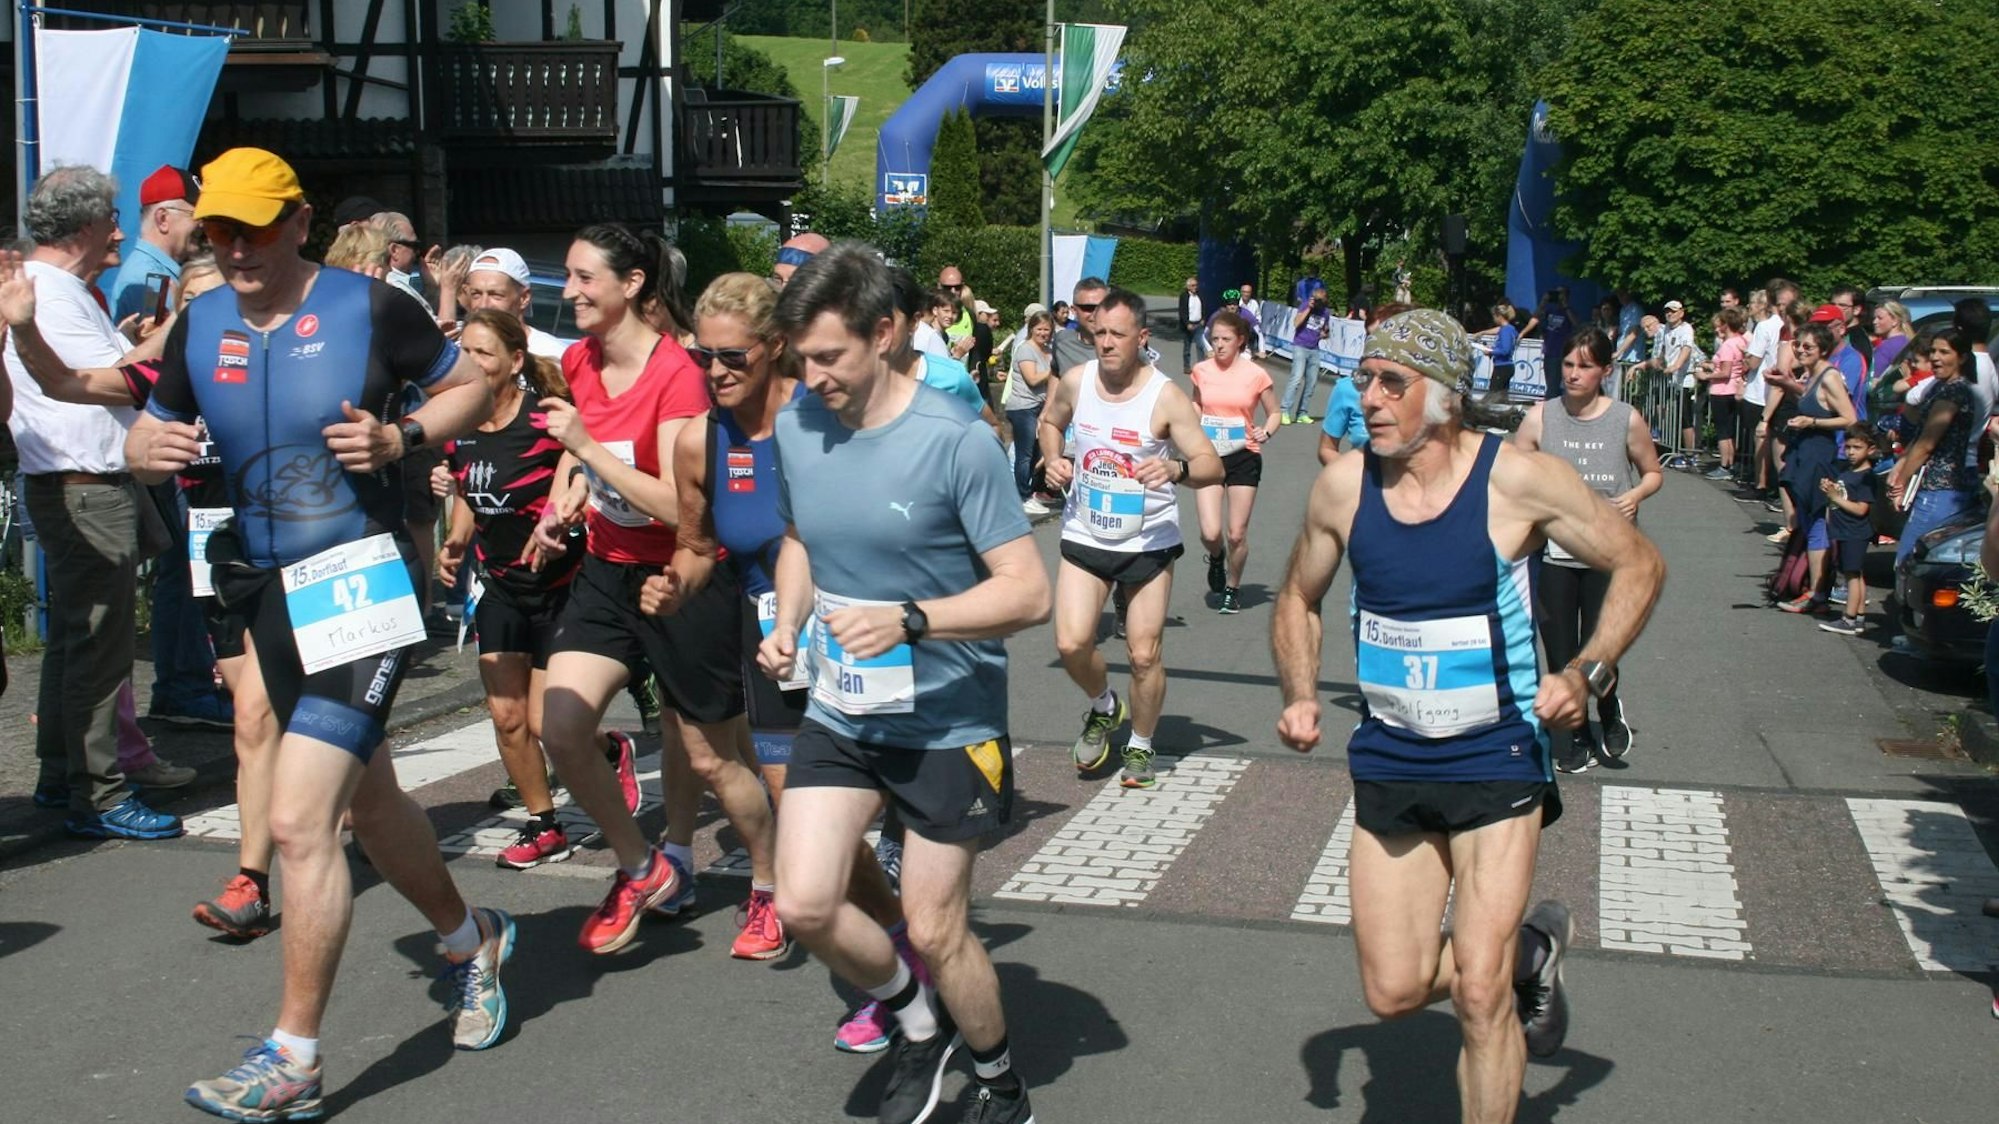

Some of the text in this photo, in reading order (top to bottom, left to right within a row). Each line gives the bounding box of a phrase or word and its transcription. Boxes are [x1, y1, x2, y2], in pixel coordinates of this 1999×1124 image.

[1563, 440, 1604, 450] THE KEY
[1578, 457, 1588, 465] IS
[1583, 473, 1615, 482] ATION
[467, 492, 511, 507] TV
[1090, 510, 1123, 530] Hagen
[312, 557, 348, 581] Dorflauf
[331, 573, 374, 612] 42
[328, 618, 399, 648] Markus
[1382, 631, 1422, 648] Dorflauf
[837, 666, 864, 695] Jan
[1403, 654, 1438, 690] 37
